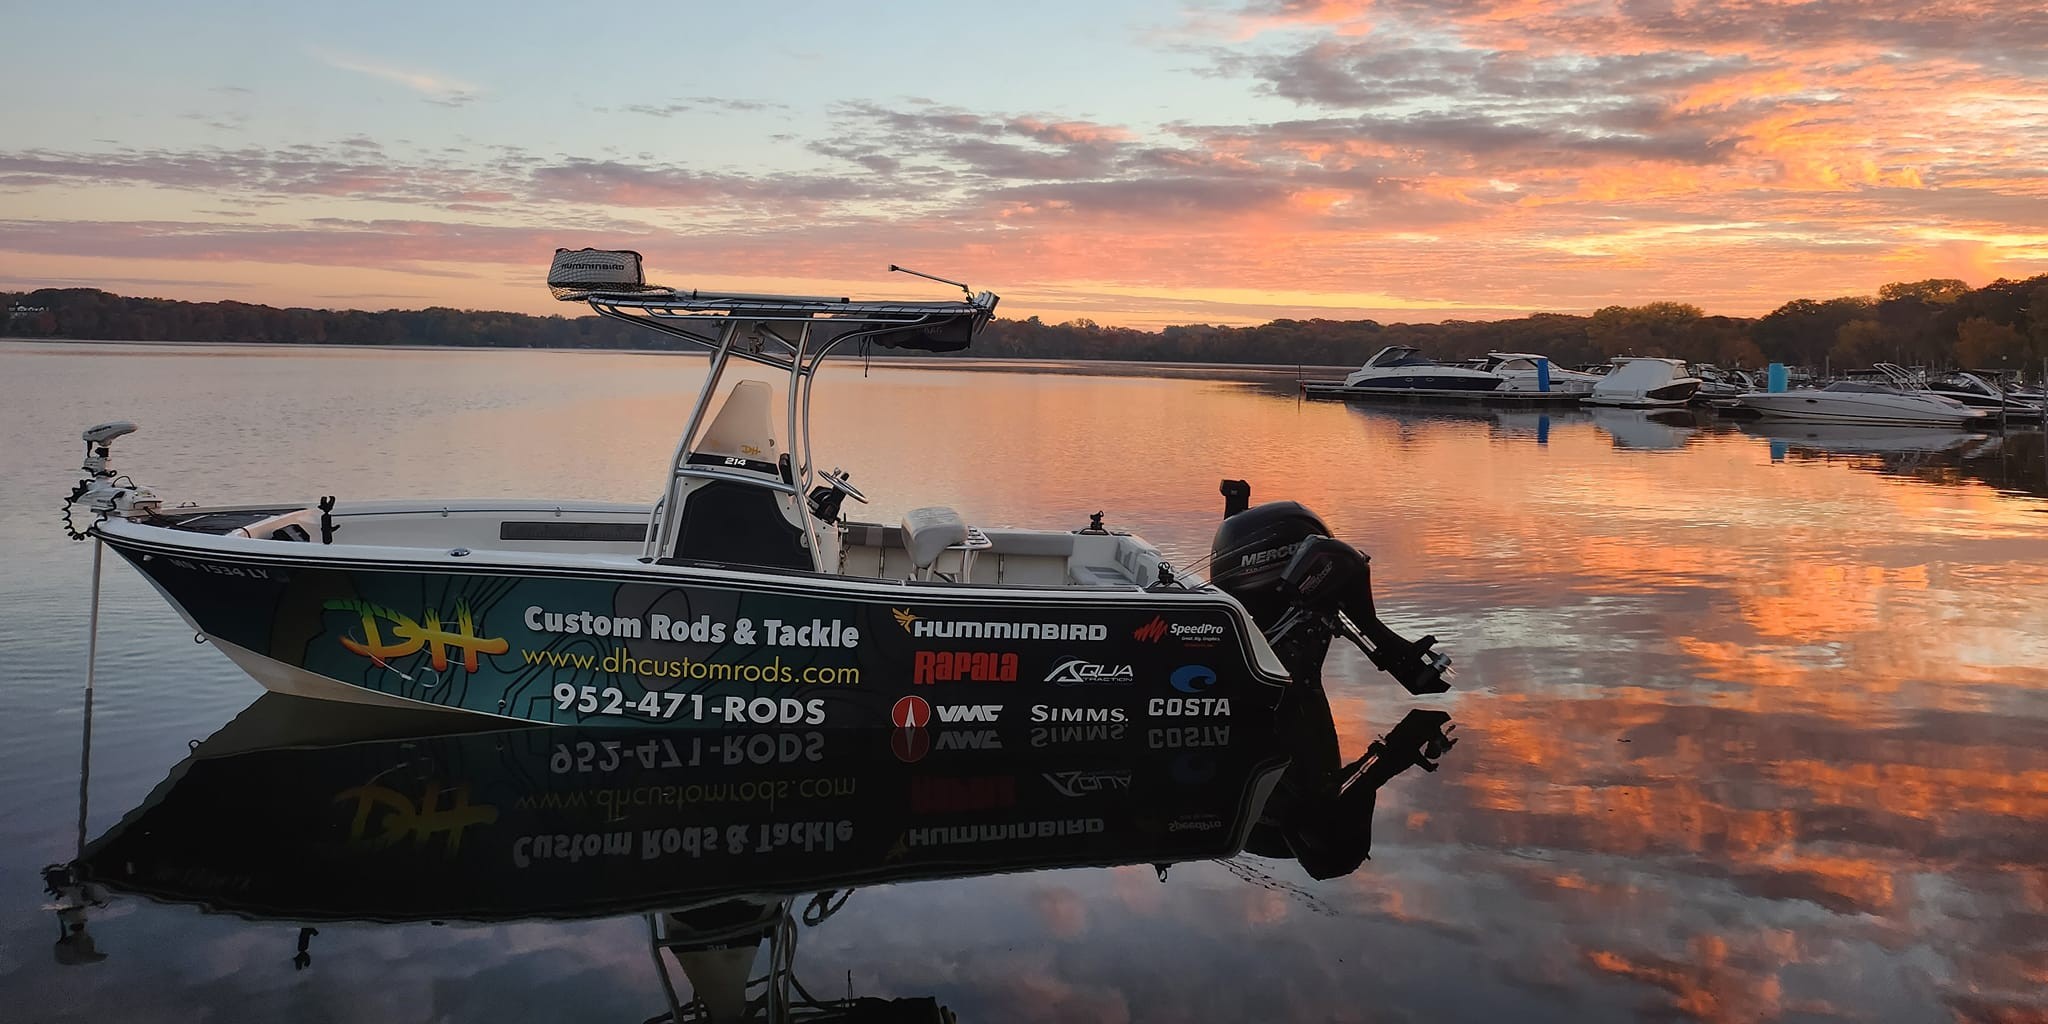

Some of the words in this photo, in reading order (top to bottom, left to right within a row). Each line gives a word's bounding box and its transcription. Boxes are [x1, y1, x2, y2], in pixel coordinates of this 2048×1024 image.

[724, 457, 747, 466] 214
[1241, 543, 1302, 567] MERCU
[200, 563, 246, 577] 1534
[247, 568, 269, 579] LY
[322, 597, 509, 673] DH
[524, 605, 642, 639] Custom
[650, 613, 727, 644] Rods
[733, 617, 757, 645] &
[763, 618, 860, 648] Tackle
[914, 620, 1107, 641] HUMMINBIRD
[1170, 623, 1224, 636] SpeedPro
[521, 647, 860, 685] www.dhcustomrods.com
[553, 682, 827, 726] 952-471-RODS
[935, 704, 1004, 723] VMC
[1148, 698, 1231, 716] COSTA
